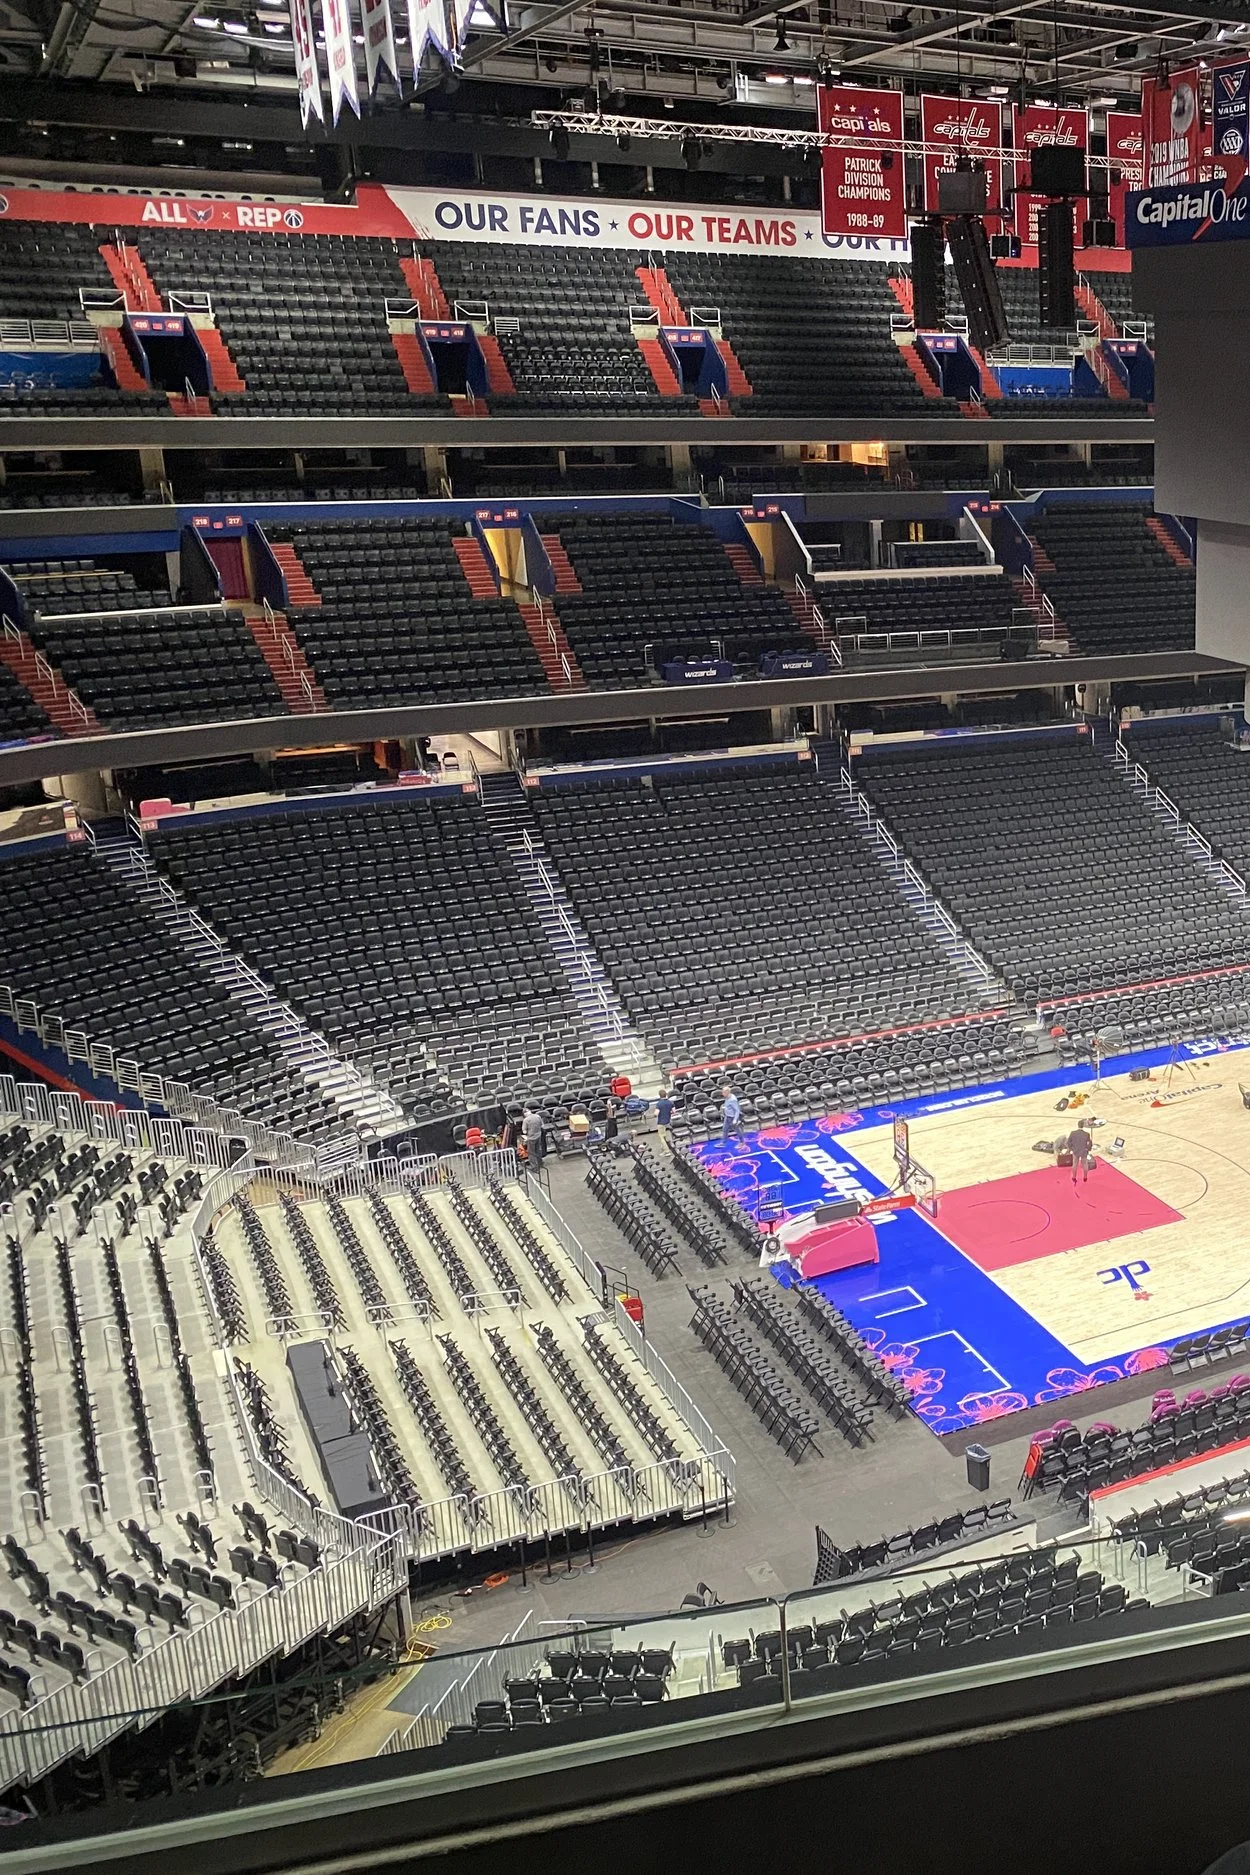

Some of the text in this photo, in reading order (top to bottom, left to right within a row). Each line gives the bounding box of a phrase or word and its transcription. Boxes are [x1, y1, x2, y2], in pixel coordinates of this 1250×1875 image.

[1218, 103, 1247, 115] VALOR
[844, 157, 882, 172] PATRICK
[844, 172, 884, 187] DIVISION
[837, 185, 891, 201] CHAMPIONS
[141, 201, 282, 228] ALL REP
[846, 212, 885, 229] 1988-89
[434, 201, 508, 233] OUR
[520, 207, 601, 237] FANS
[628, 211, 695, 243] OUR
[702, 216, 798, 247] TEAMS
[782, 660, 813, 670] wizards
[684, 668, 717, 678] wizards
[1121, 1090, 1160, 1101] Arena
